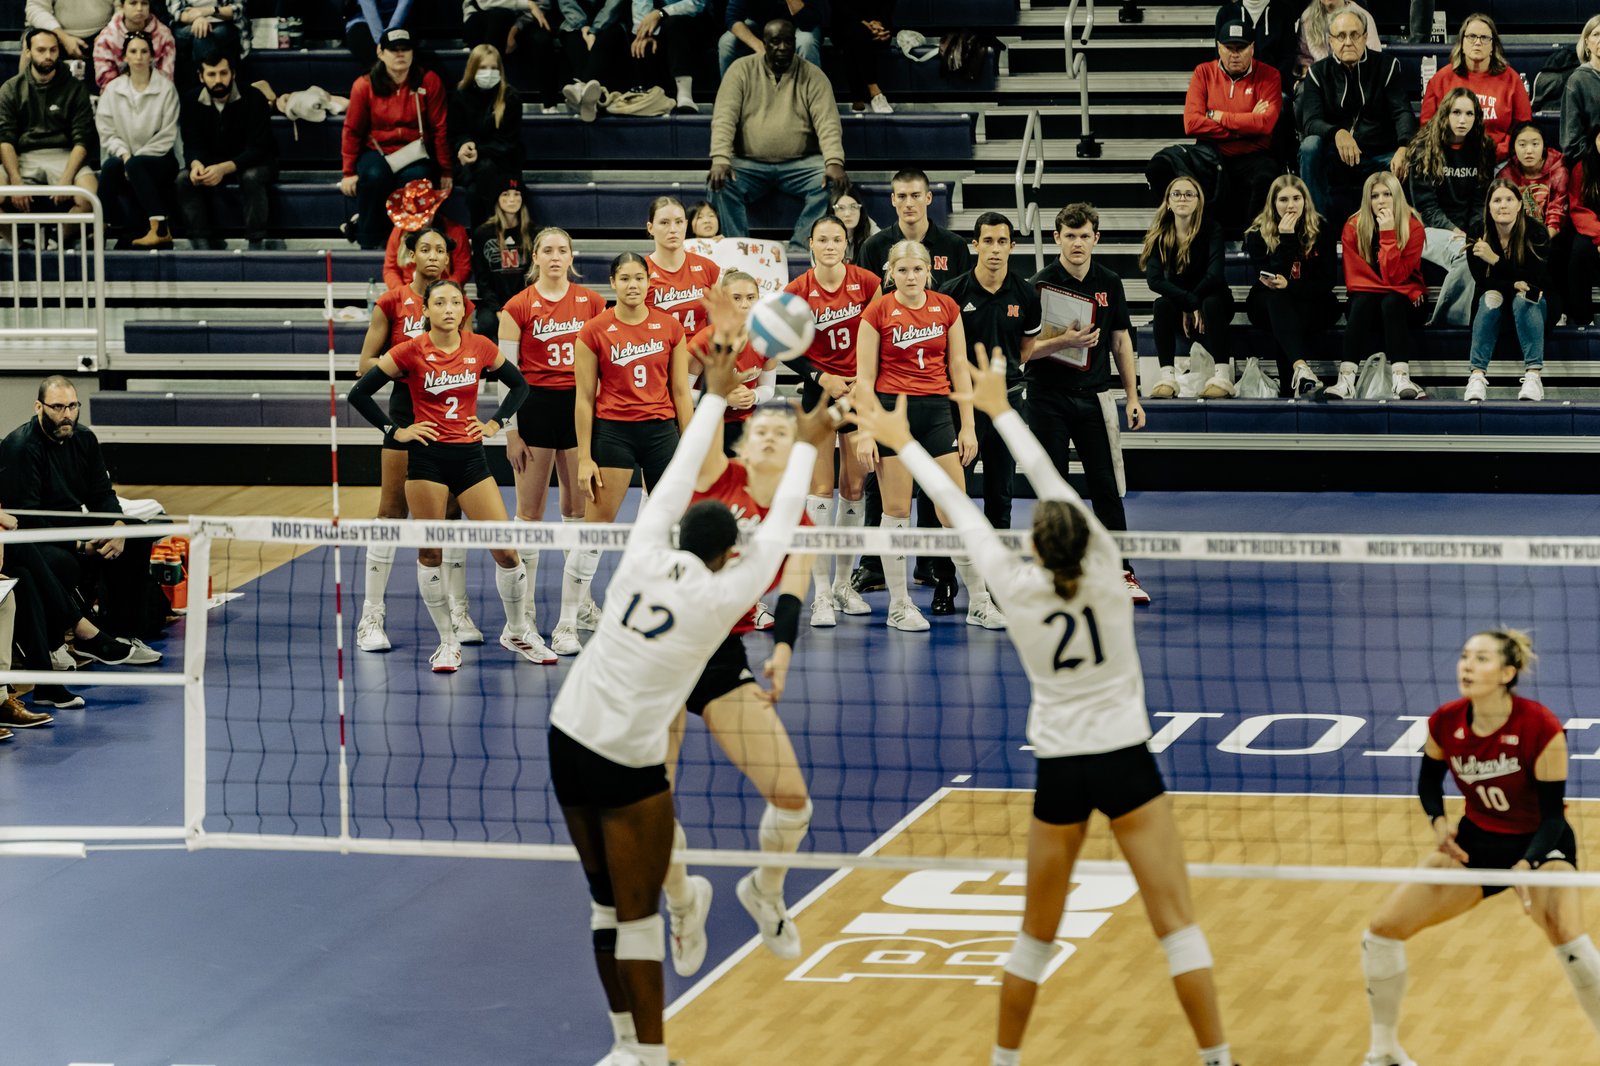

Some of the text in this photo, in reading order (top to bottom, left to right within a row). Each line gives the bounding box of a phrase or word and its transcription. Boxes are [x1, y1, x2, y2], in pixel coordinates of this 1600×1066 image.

[501, 249, 519, 268] N
[934, 256, 948, 271] N
[654, 284, 705, 305] Nebraska
[1095, 292, 1108, 307] N
[810, 301, 862, 325] Nebraska
[1007, 304, 1020, 318] N
[532, 316, 585, 336] Nebraska
[892, 321, 944, 343] Nebraska
[610, 337, 665, 363] Nebraska
[828, 327, 851, 350] 13
[547, 342, 575, 367] 33
[916, 347, 925, 370] 1
[424, 368, 477, 389] Nebraska
[633, 364, 647, 388] 9
[445, 396, 459, 420] 2
[271, 521, 401, 542] NORTHWESTERN
[425, 525, 555, 544] NORTHWESTERN
[1206, 538, 1341, 556] NORTHWESTERN
[1366, 540, 1503, 558] NORTHWESTERN
[164, 570, 172, 582] G
[621, 592, 675, 640] 12
[1043, 606, 1106, 672] 21
[1449, 751, 1522, 777] Nebraska
[1475, 784, 1511, 812] 10
